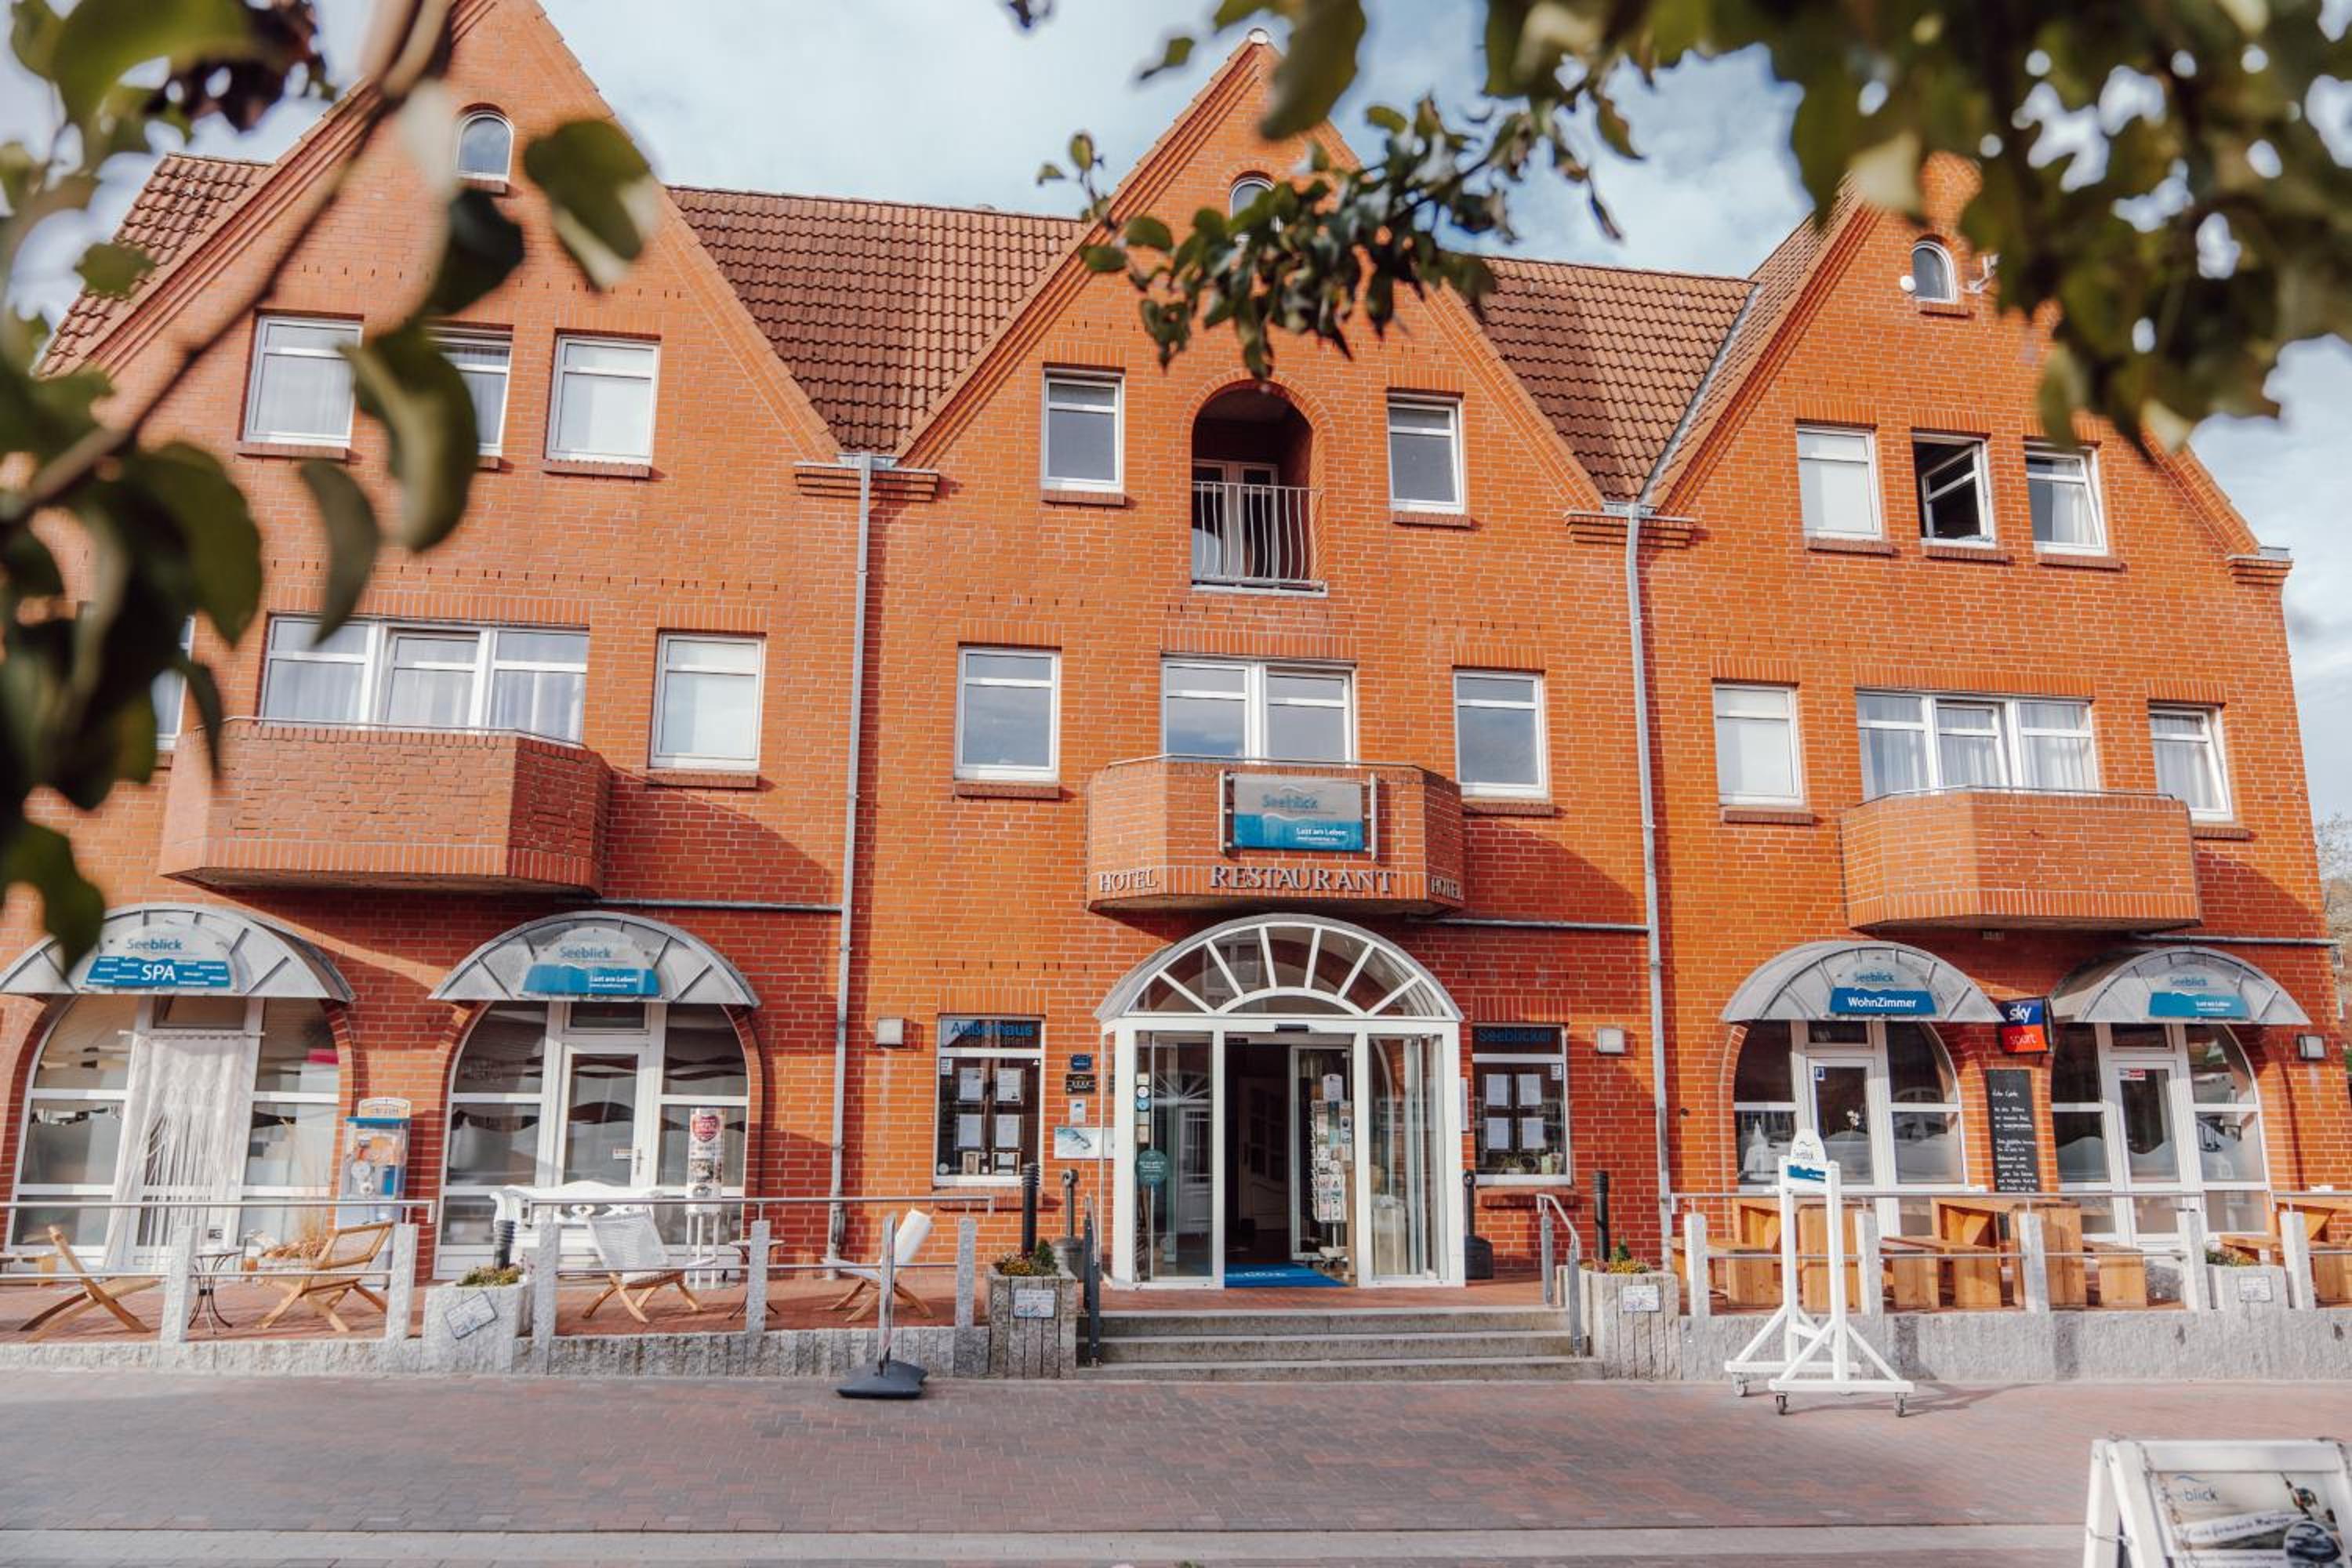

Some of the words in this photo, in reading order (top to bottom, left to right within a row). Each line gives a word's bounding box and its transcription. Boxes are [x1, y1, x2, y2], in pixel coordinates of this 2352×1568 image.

[1099, 869, 1157, 892] HOTEL
[1210, 865, 1397, 894] RESTAURANT
[1430, 876, 1465, 901] HOTEL
[125, 938, 182, 951] Seeblick
[559, 946, 612, 959] Seeblick
[142, 964, 176, 981] SPA
[1853, 971, 1894, 983] Seeblick
[2169, 977, 2208, 987] Seeblick
[1848, 996, 1917, 1008] WohnZimmer
[2009, 1004, 2032, 1024] sky
[2009, 1034, 2037, 1046] sport
